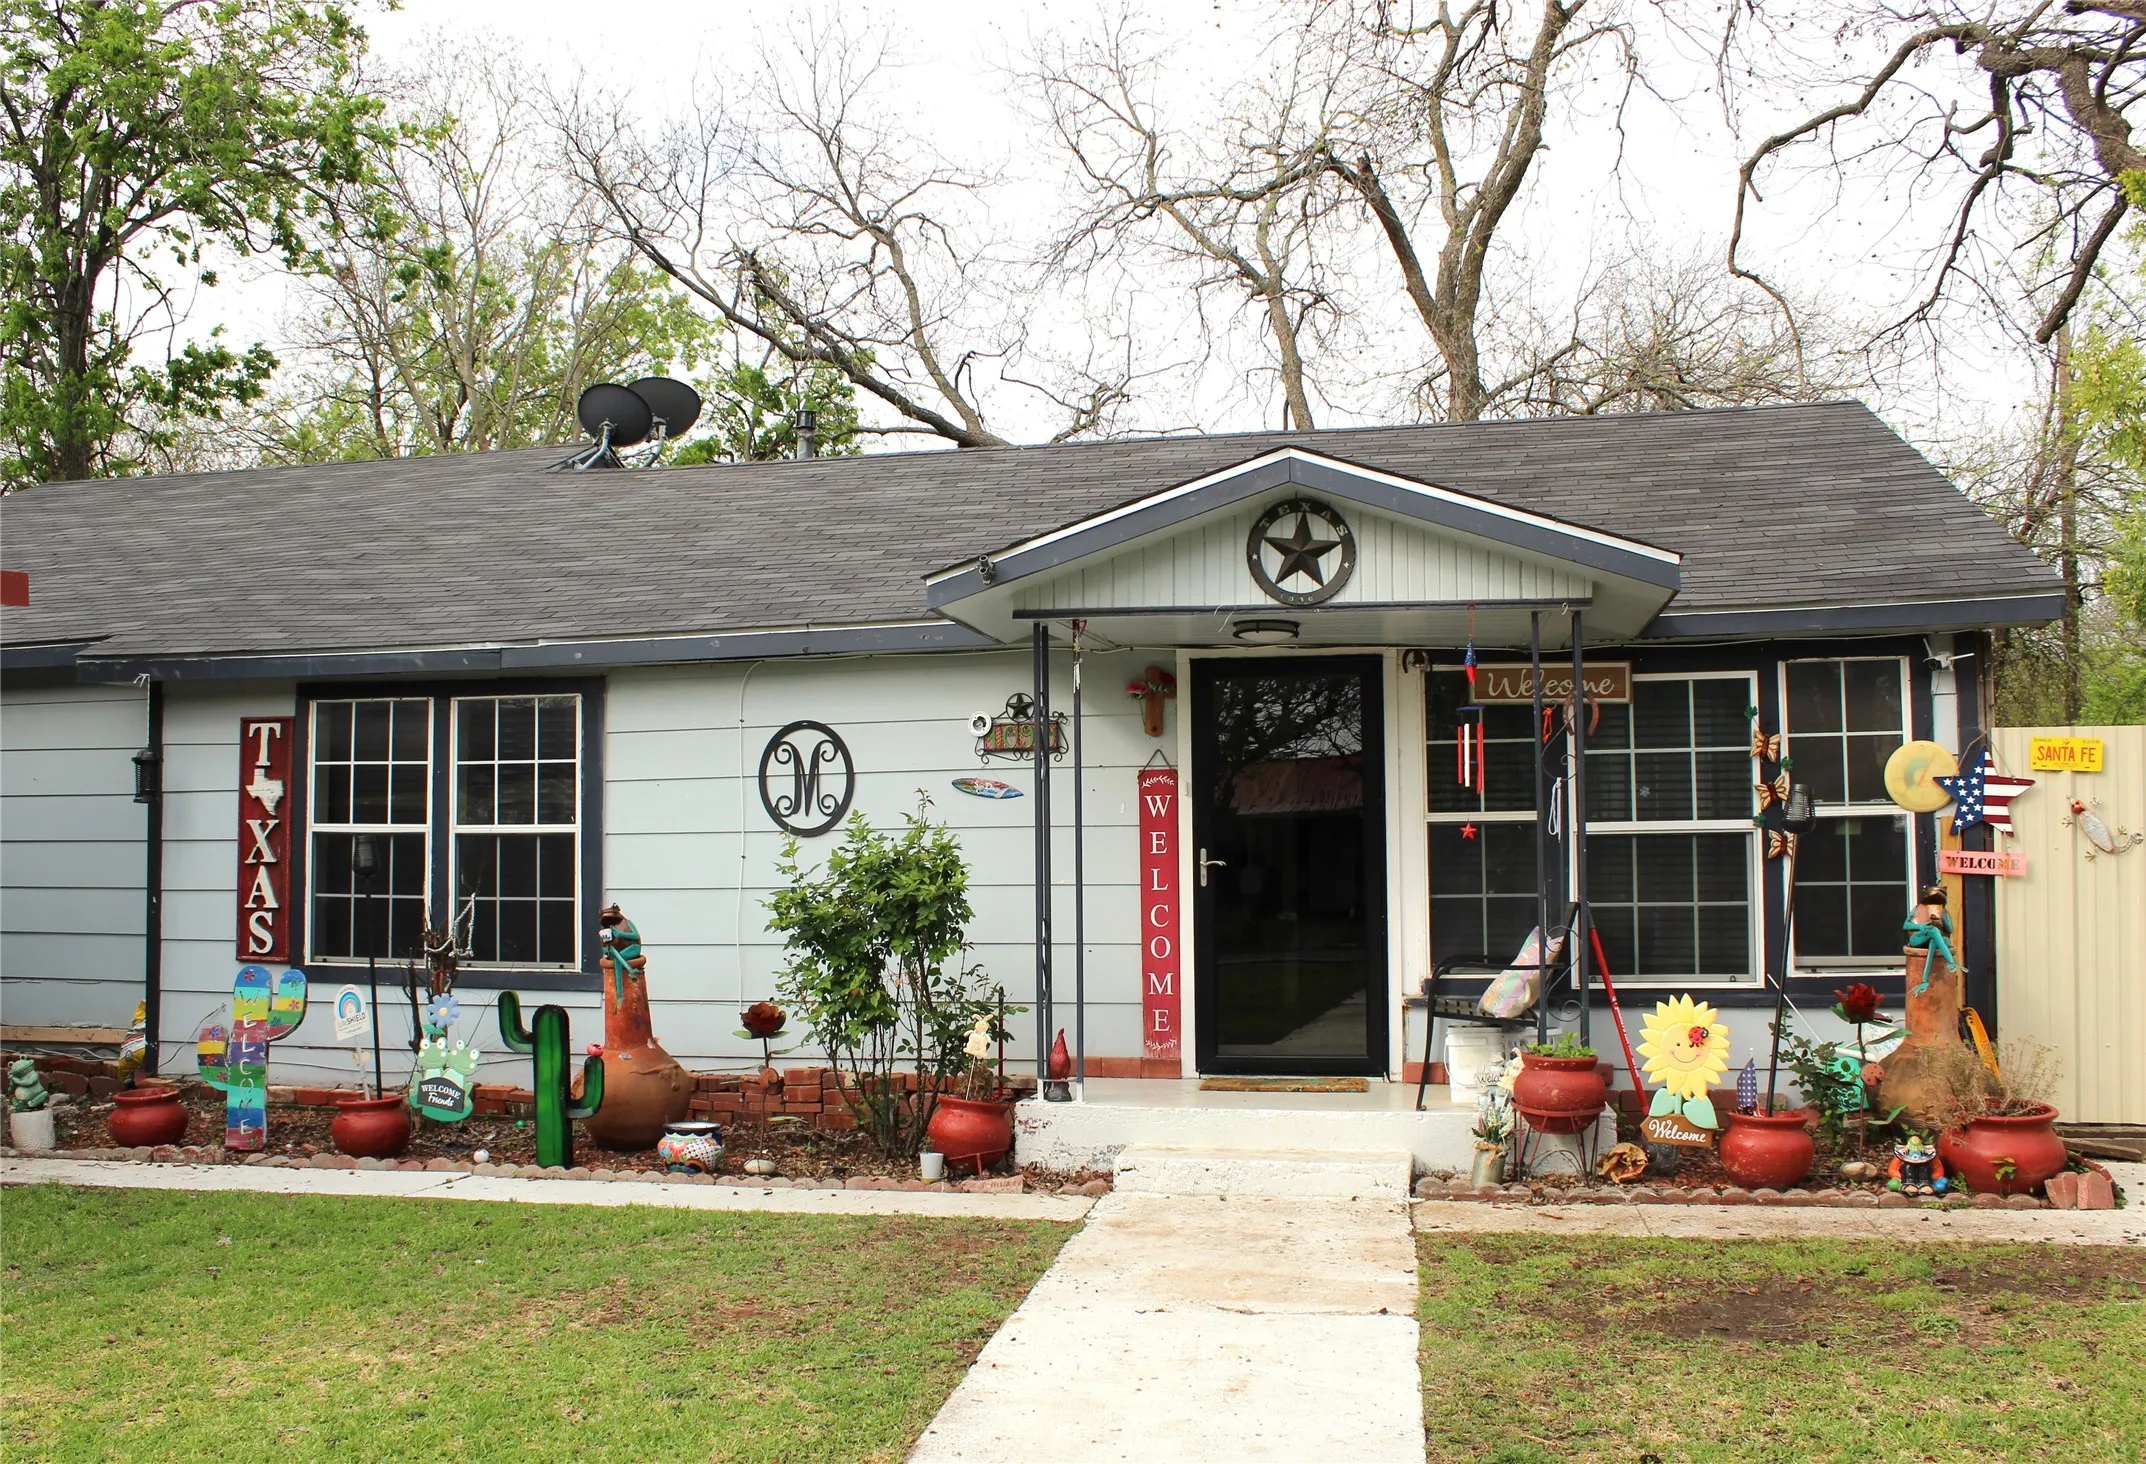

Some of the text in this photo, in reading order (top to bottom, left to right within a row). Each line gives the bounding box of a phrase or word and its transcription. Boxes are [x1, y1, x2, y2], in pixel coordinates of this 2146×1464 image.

[1259, 501, 1349, 537] TEXAS
[1487, 668, 1615, 698] Welcome
[2037, 745, 2096, 763] SANTA FE
[773, 739, 840, 818] M
[1946, 856, 2020, 870] WELCOME
[1144, 795, 1173, 1032] WELCOME
[239, 989, 261, 1135] WELCOME
[421, 1084, 461, 1099] WELCOME
[428, 1092, 454, 1107] Friends
[1648, 1119, 1706, 1143] Welcome
